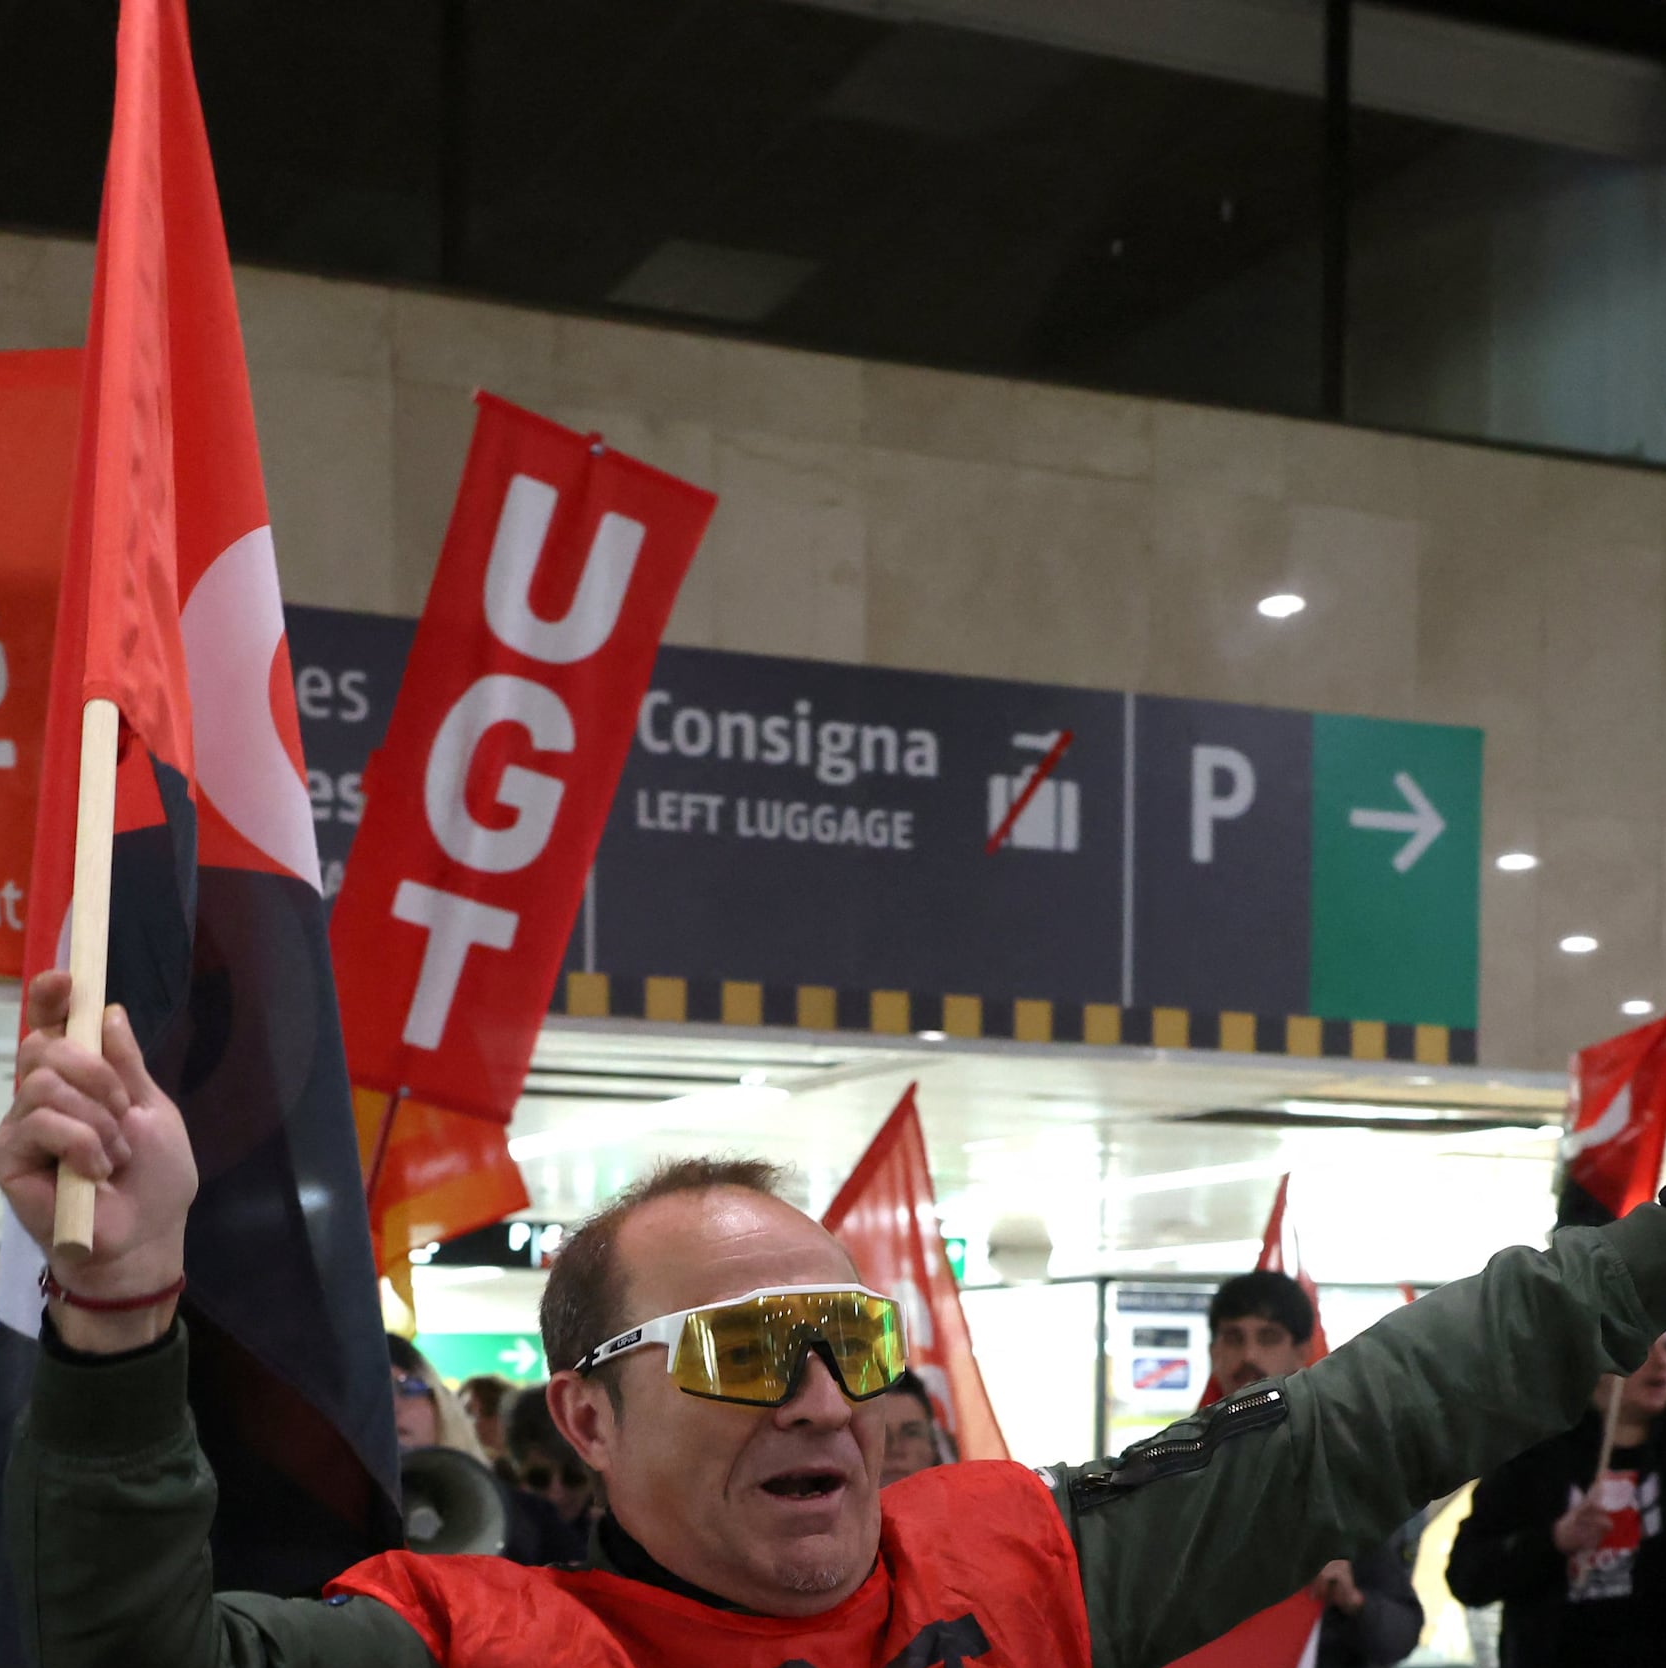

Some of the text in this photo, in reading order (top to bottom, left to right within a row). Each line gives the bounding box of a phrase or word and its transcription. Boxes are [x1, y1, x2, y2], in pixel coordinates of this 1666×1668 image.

[391, 473, 647, 1052] UGT
[637, 689, 939, 786] Consigna
[636, 788, 915, 851] LEFT LUGGAGE
[1191, 744, 1257, 864] P
